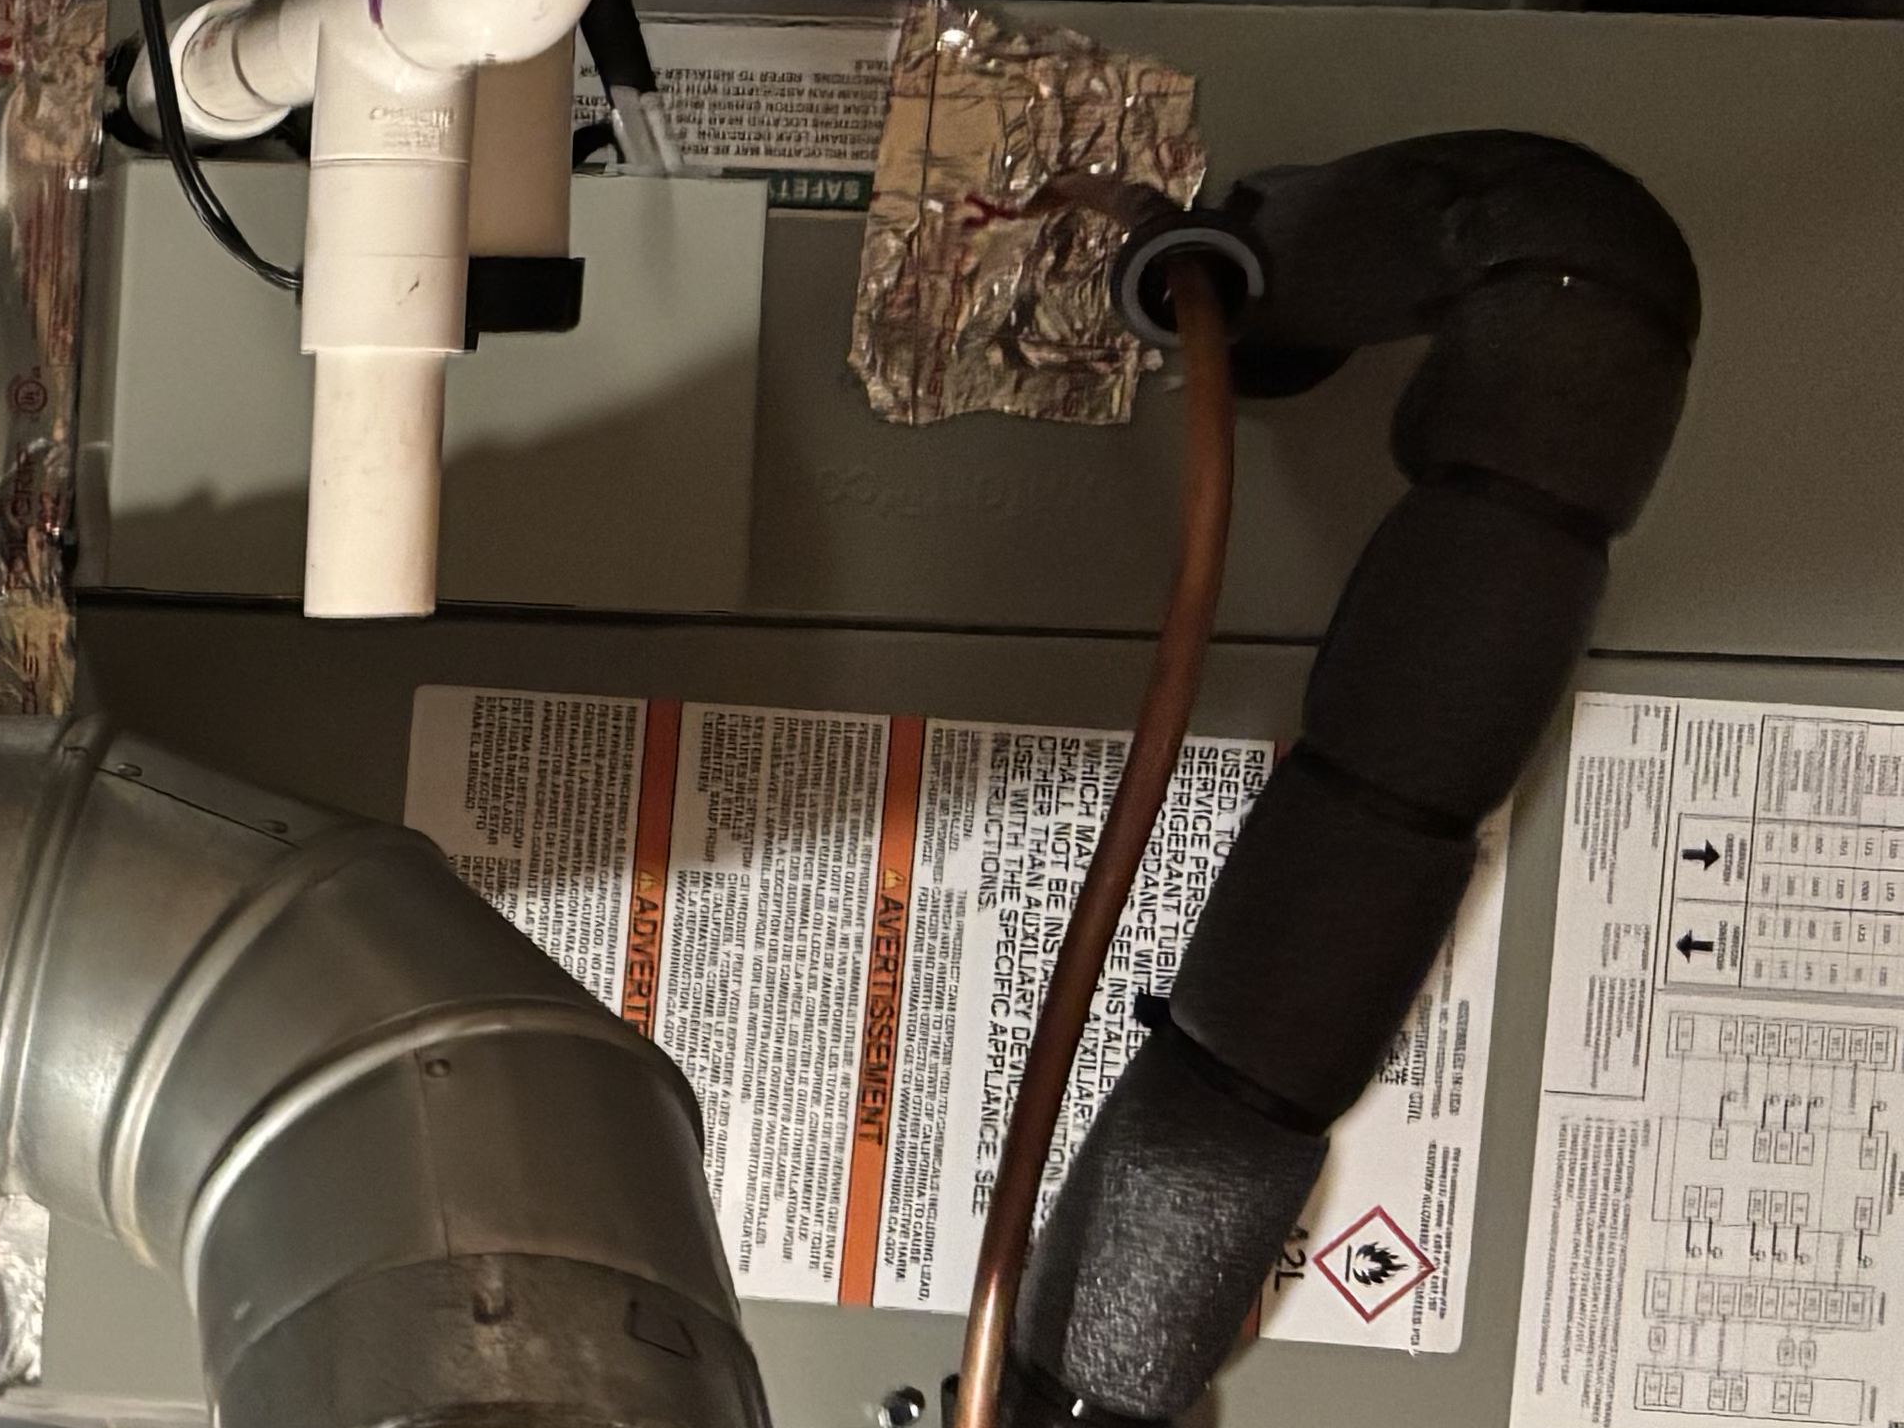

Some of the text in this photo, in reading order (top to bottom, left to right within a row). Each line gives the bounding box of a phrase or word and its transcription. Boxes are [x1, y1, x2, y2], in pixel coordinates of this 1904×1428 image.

[976, 731, 1011, 913] INSTRUCTIONS.
[1043, 735, 1078, 911] SHALL NOT BE
[1077, 737, 1103, 817] WHICH
[1160, 744, 1194, 912] REFRIGERANT
[1189, 746, 1218, 850] SERVICE
[1217, 747, 1241, 817] USED.
[1013, 735, 1056, 1017] OTHER THAN AUXILIARY
[1072, 824, 1096, 871] MAY
[969, 733, 1034, 1218] USE WITH THE SPECIFIC APPLIANCE. SEE
[1108, 921, 1133, 972] SEE
[858, 893, 904, 1145] AVERTISSEMENT
[914, 1201, 926, 1218] TO
